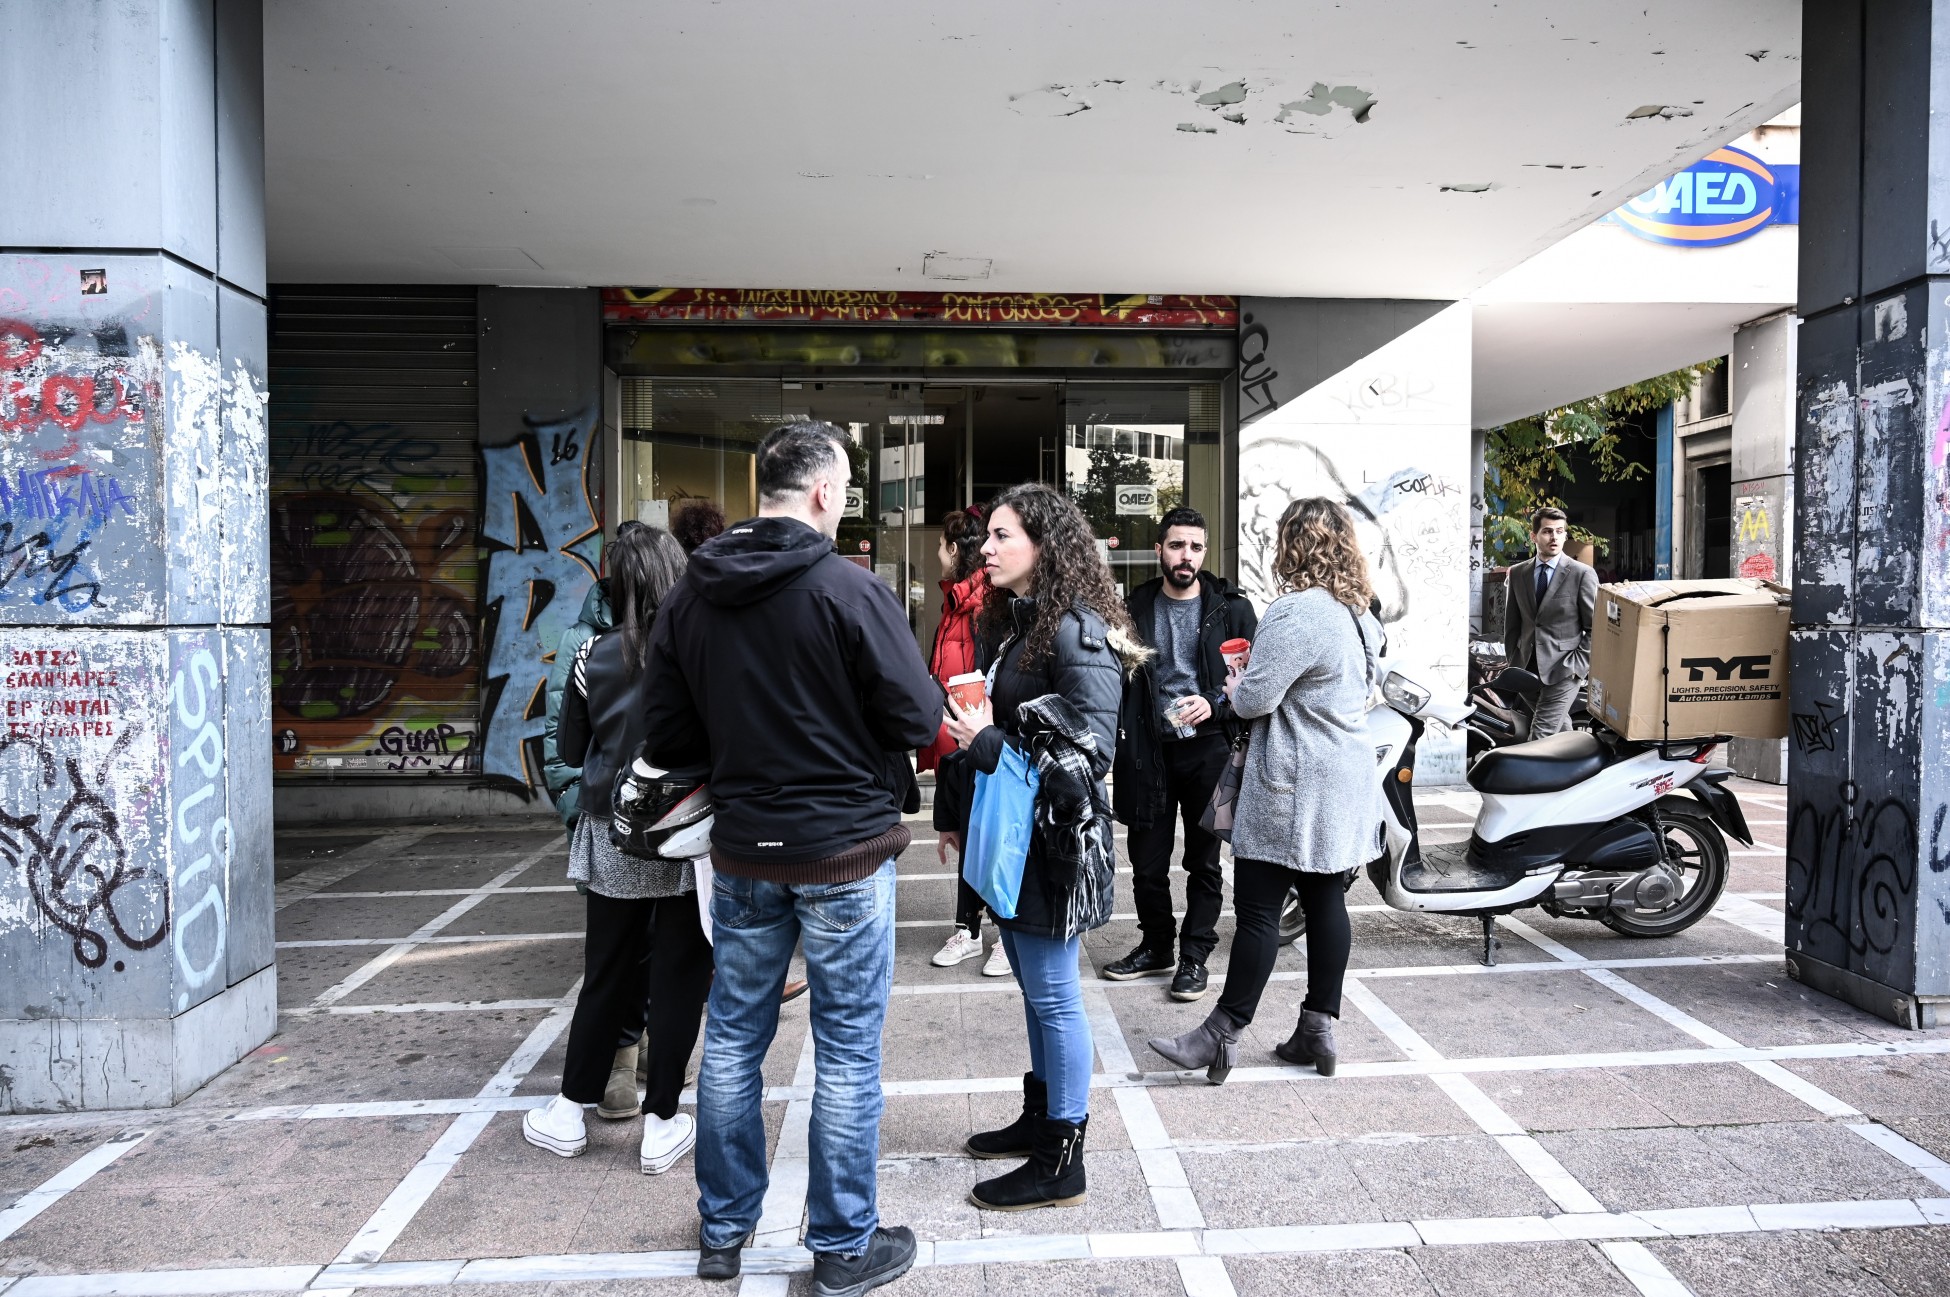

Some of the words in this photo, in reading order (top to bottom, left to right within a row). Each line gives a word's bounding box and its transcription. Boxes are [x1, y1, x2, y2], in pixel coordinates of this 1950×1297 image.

[1680, 655, 1772, 682] TYC
[1671, 686, 1702, 694] LIGHTS.
[1703, 685, 1748, 693] PRECISION.
[1749, 684, 1780, 692] SAFETY
[1678, 693, 1737, 702] Automotive
[1738, 692, 1772, 701] Lamps
